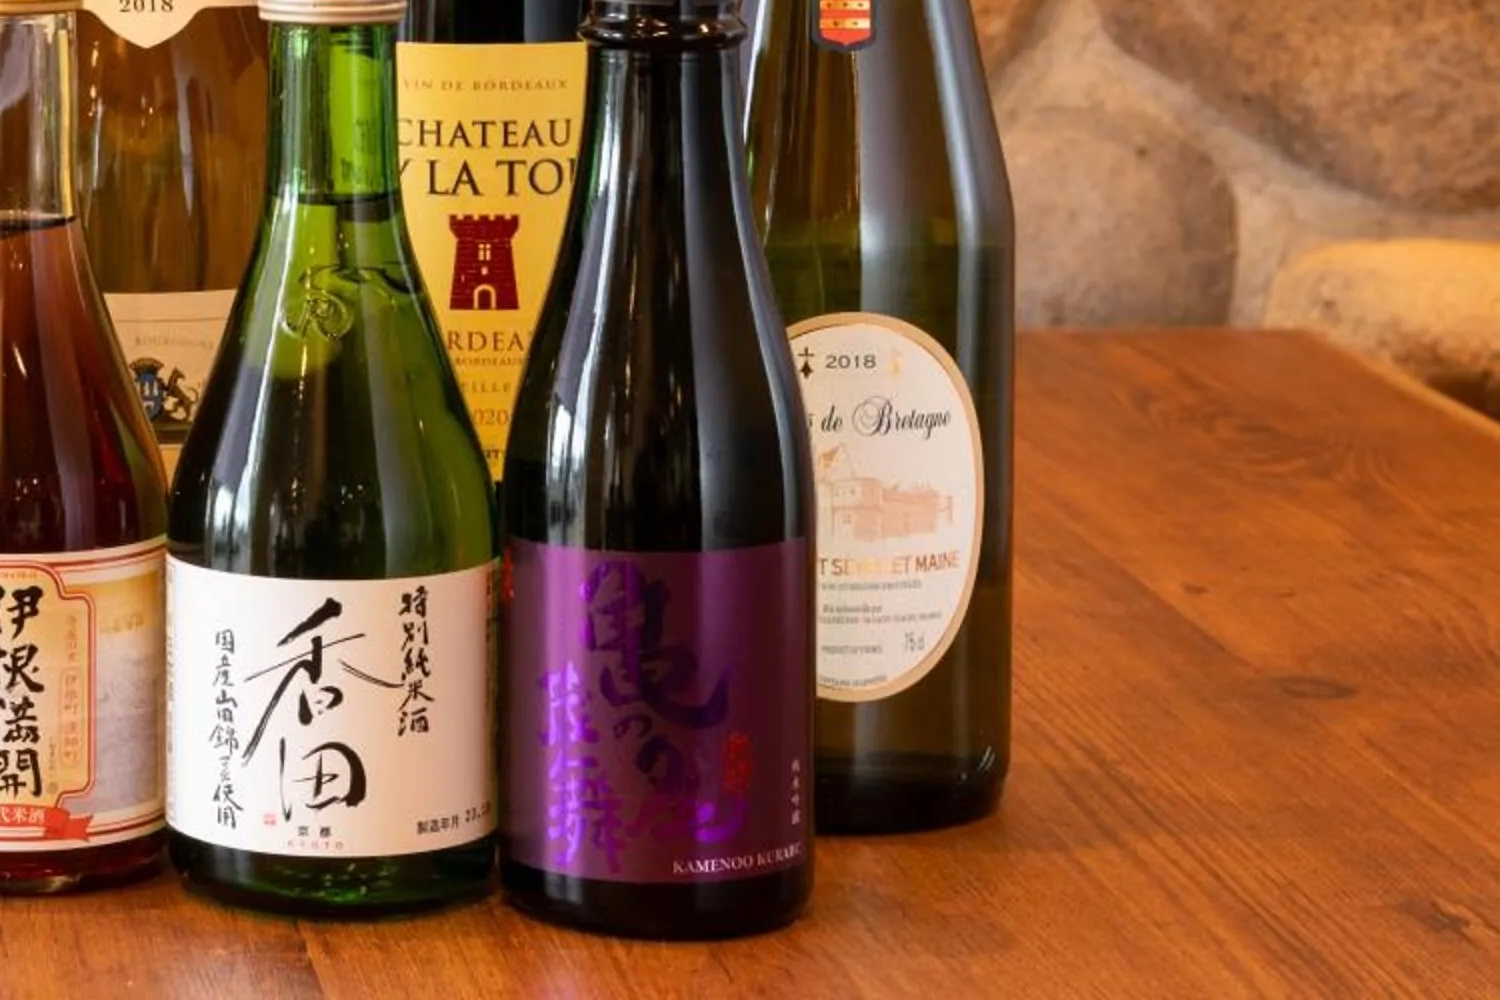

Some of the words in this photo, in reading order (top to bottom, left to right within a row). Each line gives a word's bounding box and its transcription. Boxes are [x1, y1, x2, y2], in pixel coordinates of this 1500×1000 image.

[404, 80, 433, 90] VIN
[441, 80, 464, 91] DE
[472, 79, 569, 92] BORDEAUX
[397, 118, 572, 148] CHATEAU
[428, 159, 484, 196] LA
[447, 330, 529, 352] RDEA
[825, 354, 876, 369] 2018
[820, 404, 843, 433] de
[852, 395, 951, 440] Bretagne
[398, 585, 436, 737] 特別純米酒
